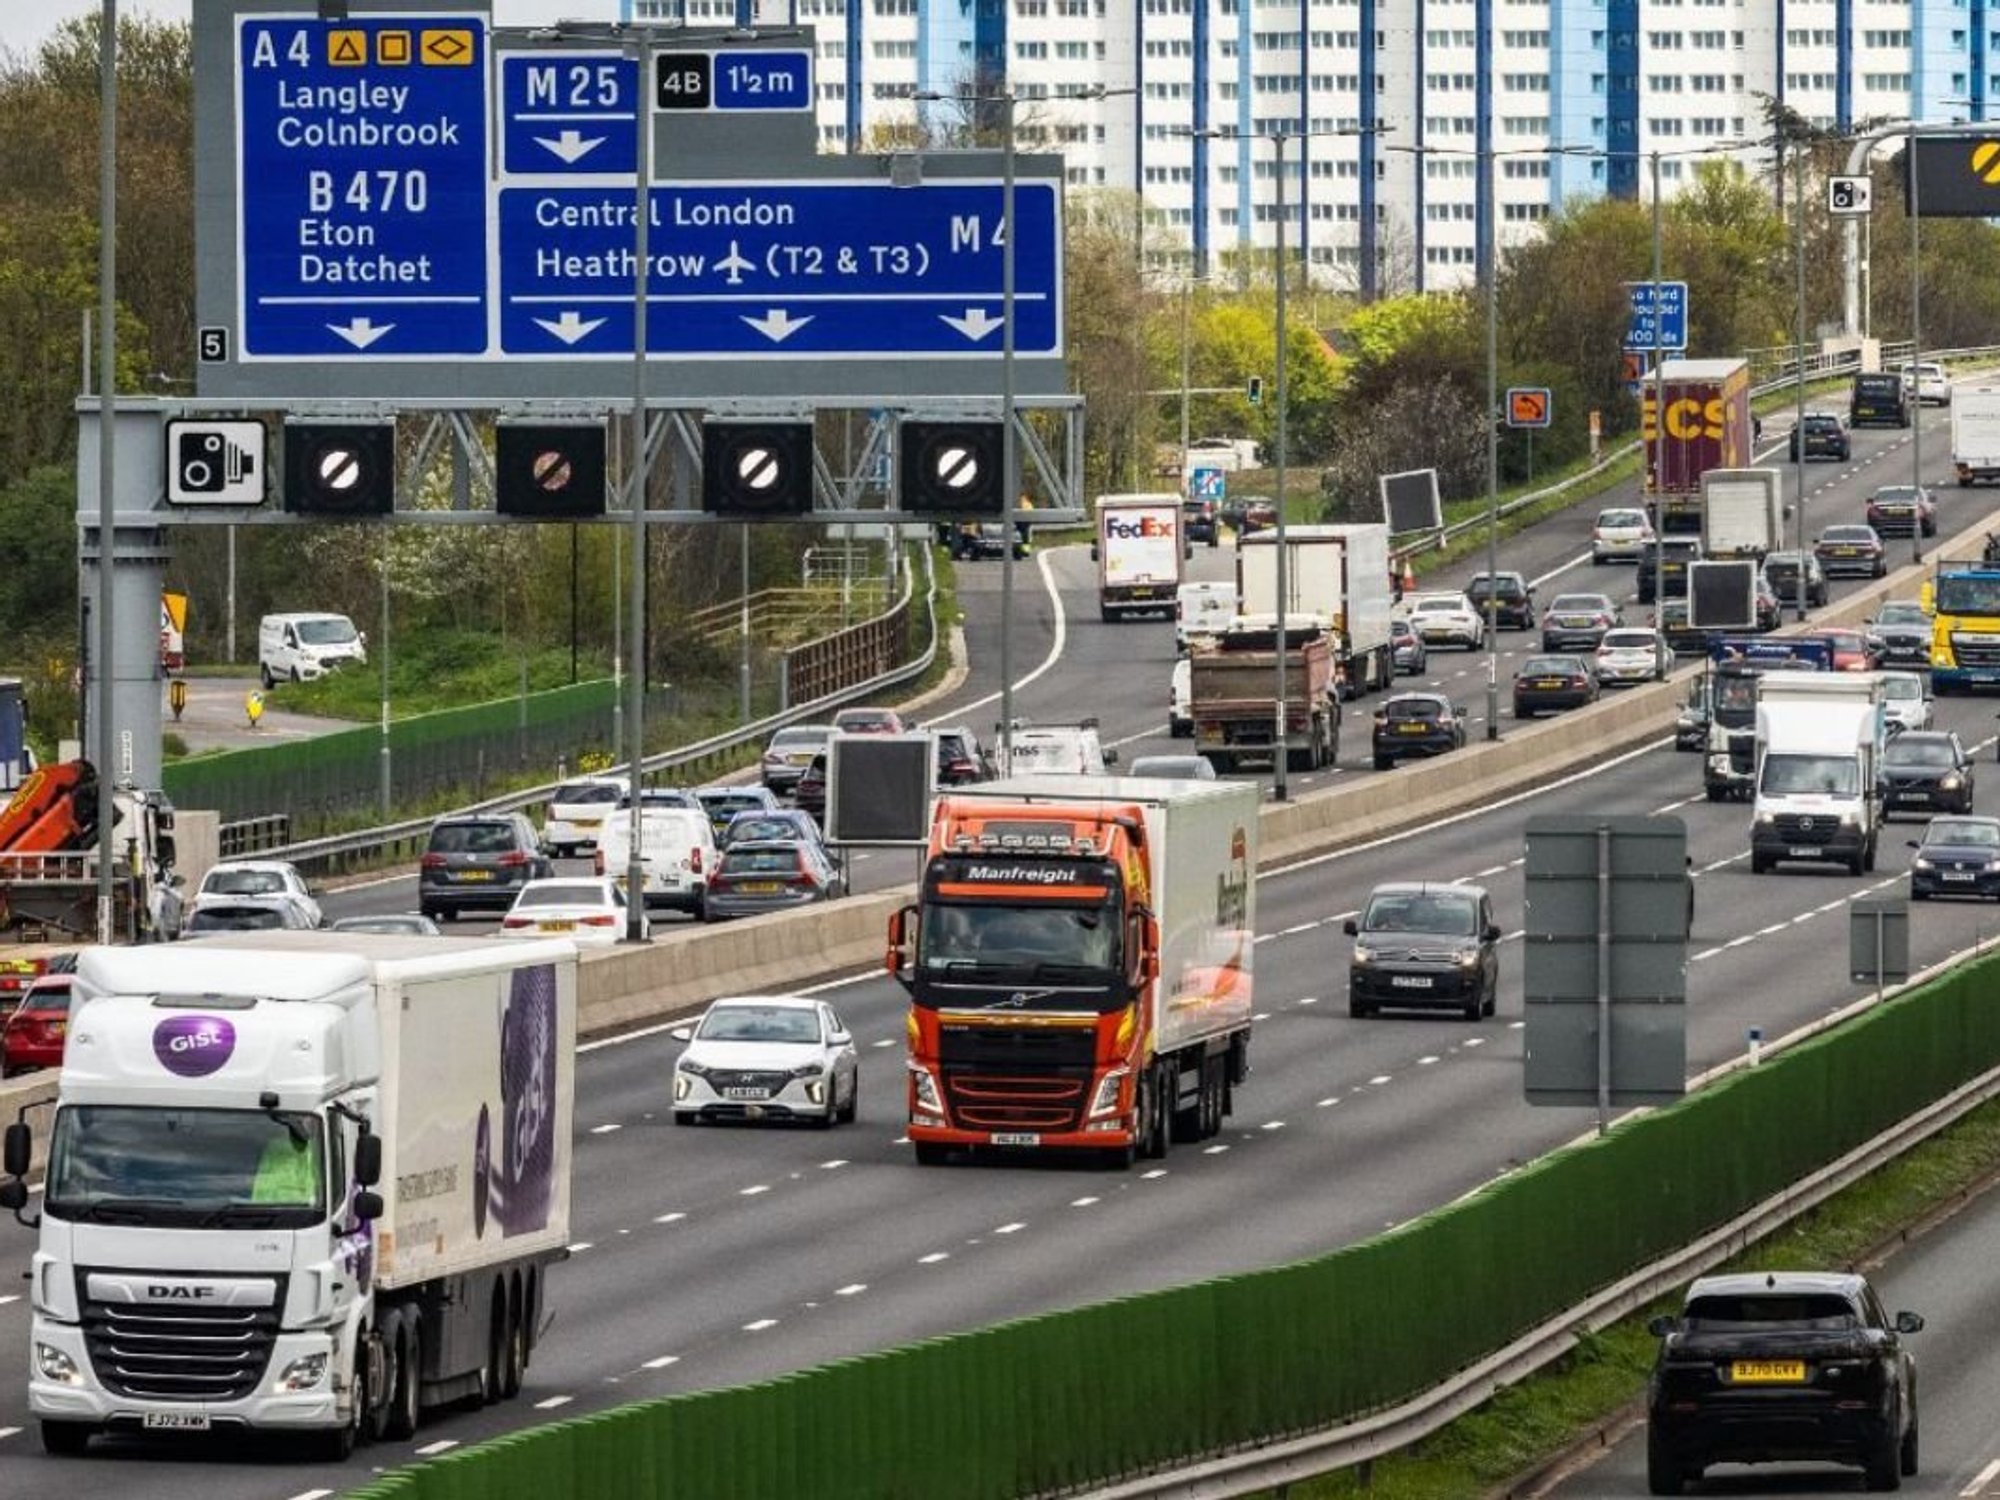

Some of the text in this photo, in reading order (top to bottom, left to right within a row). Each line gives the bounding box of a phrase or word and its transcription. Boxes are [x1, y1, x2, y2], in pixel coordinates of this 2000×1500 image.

[663, 72, 702, 94] 4B
[278, 80, 409, 114] Langley
[278, 117, 459, 147] Colnbrook
[676, 199, 794, 227] London
[300, 219, 374, 246] Eton
[301, 255, 431, 283] Datchet
[766, 243, 823, 278] (T2
[837, 246, 858, 274] &
[869, 243, 929, 277] T3)
[205, 334, 220, 357] 5
[1106, 517, 1174, 539] FedEx
[968, 865, 1076, 883] Manfreight
[148, 1285, 214, 1299] DAF
